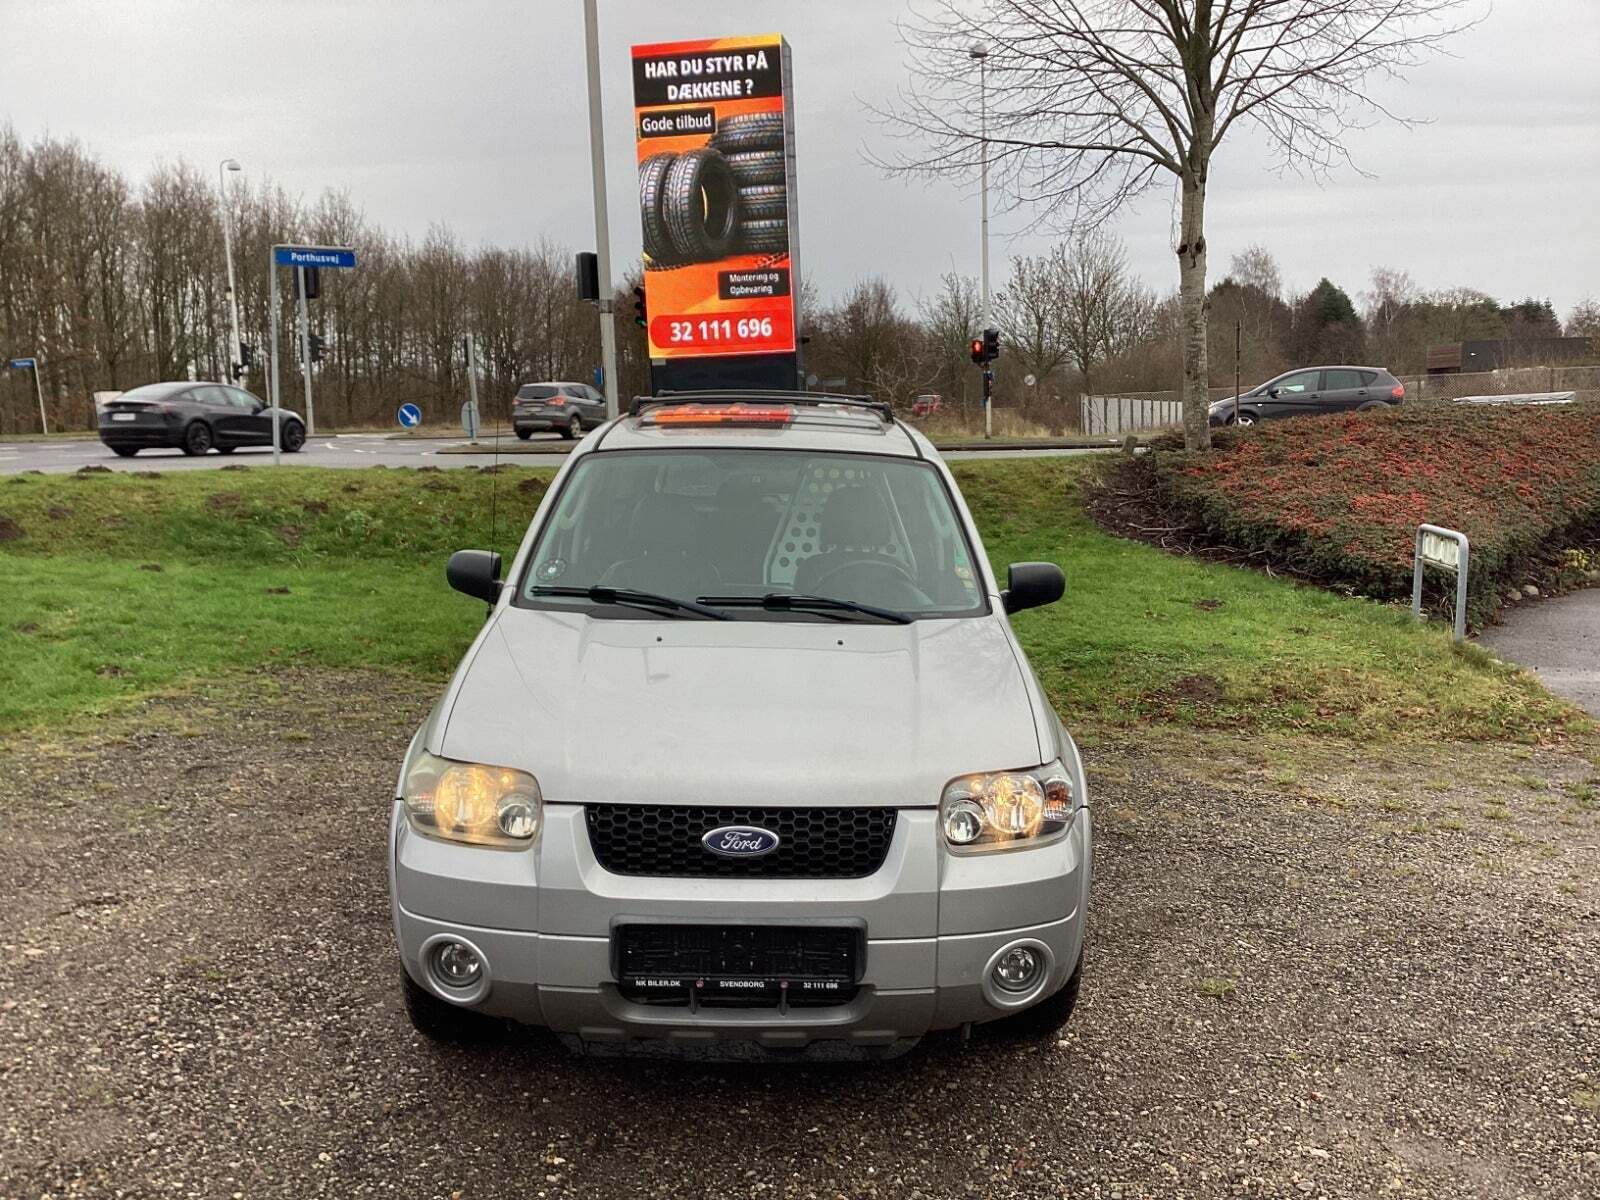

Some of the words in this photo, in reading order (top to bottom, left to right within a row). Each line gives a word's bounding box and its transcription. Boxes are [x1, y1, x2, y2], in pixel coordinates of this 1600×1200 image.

[644, 60, 677, 79] HAR
[680, 58, 702, 76] DU
[705, 56, 744, 74] STYR
[746, 51, 768, 71] PÅ
[667, 80, 742, 100] DÆKKENE
[745, 79, 754, 95] ?
[641, 116, 674, 132] Gode
[676, 113, 712, 130] tilbud
[291, 252, 339, 265] Porthusvej
[729, 273, 768, 283] Montering
[769, 272, 779, 283] og
[730, 285, 773, 296] Opbevaring
[670, 321, 693, 342] 32
[698, 319, 731, 340] 111
[737, 317, 773, 338] 696
[720, 831, 763, 850] Ford
[719, 980, 765, 988] SVENDBORG
